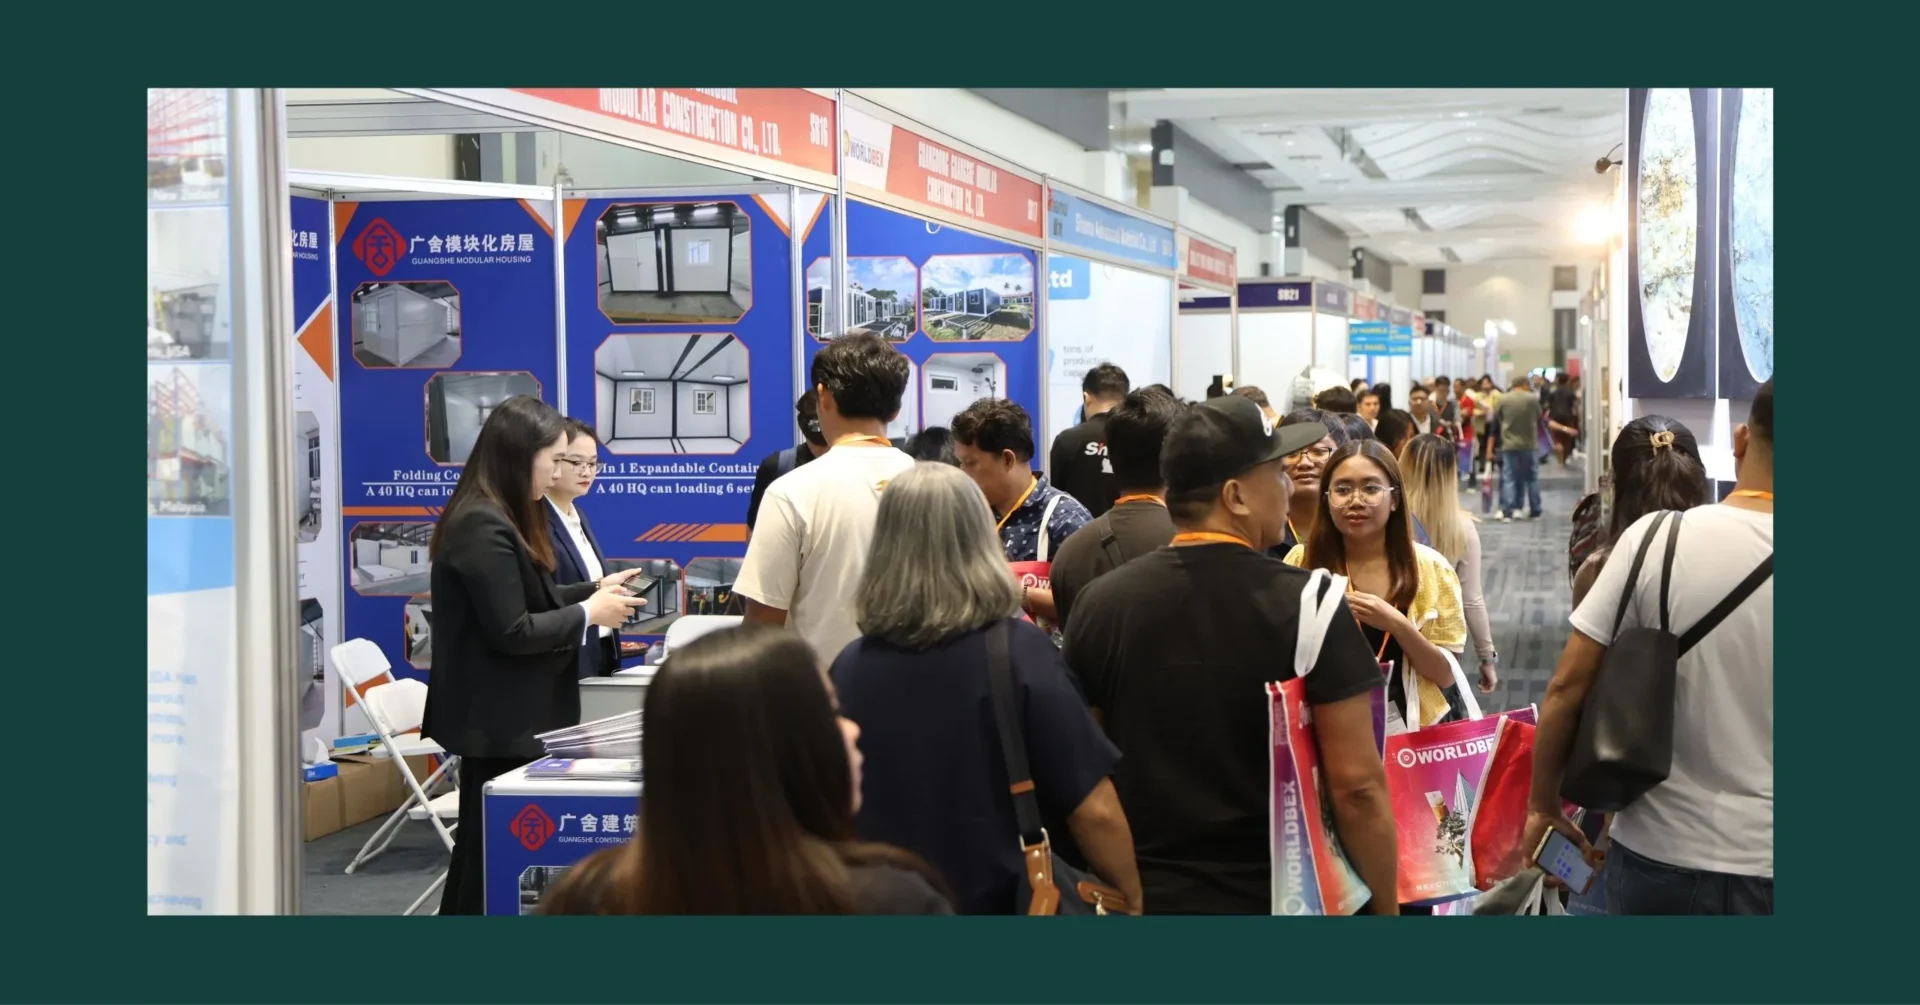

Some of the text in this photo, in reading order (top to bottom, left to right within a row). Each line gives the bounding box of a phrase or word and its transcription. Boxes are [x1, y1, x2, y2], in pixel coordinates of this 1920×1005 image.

[599, 88, 657, 124] MODULAR
[663, 90, 737, 146] CONSTRUCTION
[741, 115, 759, 156] CO.,
[762, 120, 781, 156] LTD.
[809, 112, 828, 147] SB16
[850, 140, 884, 168] WORLDBEX
[409, 233, 535, 253] 广舍模块化房屋
[299, 252, 319, 261] HOUSING
[411, 255, 532, 265] GUANGSHE MODULAR HOUSING
[1048, 269, 1073, 289] td
[1063, 344, 1094, 354] tons of
[1063, 356, 1108, 367] producti
[393, 470, 441, 482] Folding
[620, 462, 625, 474] 1
[629, 462, 706, 476] Expandable
[366, 486, 375, 497] A
[377, 486, 392, 497] 40
[395, 486, 415, 498] HQ
[418, 488, 439, 497] can
[596, 482, 606, 494] A
[608, 482, 624, 494] 40
[627, 482, 648, 496] HQ
[650, 485, 673, 494] can
[676, 482, 724, 496] loading
[726, 482, 734, 494] 6
[558, 813, 641, 834] 广舍建筑
[558, 836, 594, 844] GUANGSHE
[1283, 779, 1304, 894] WORLDBEX
